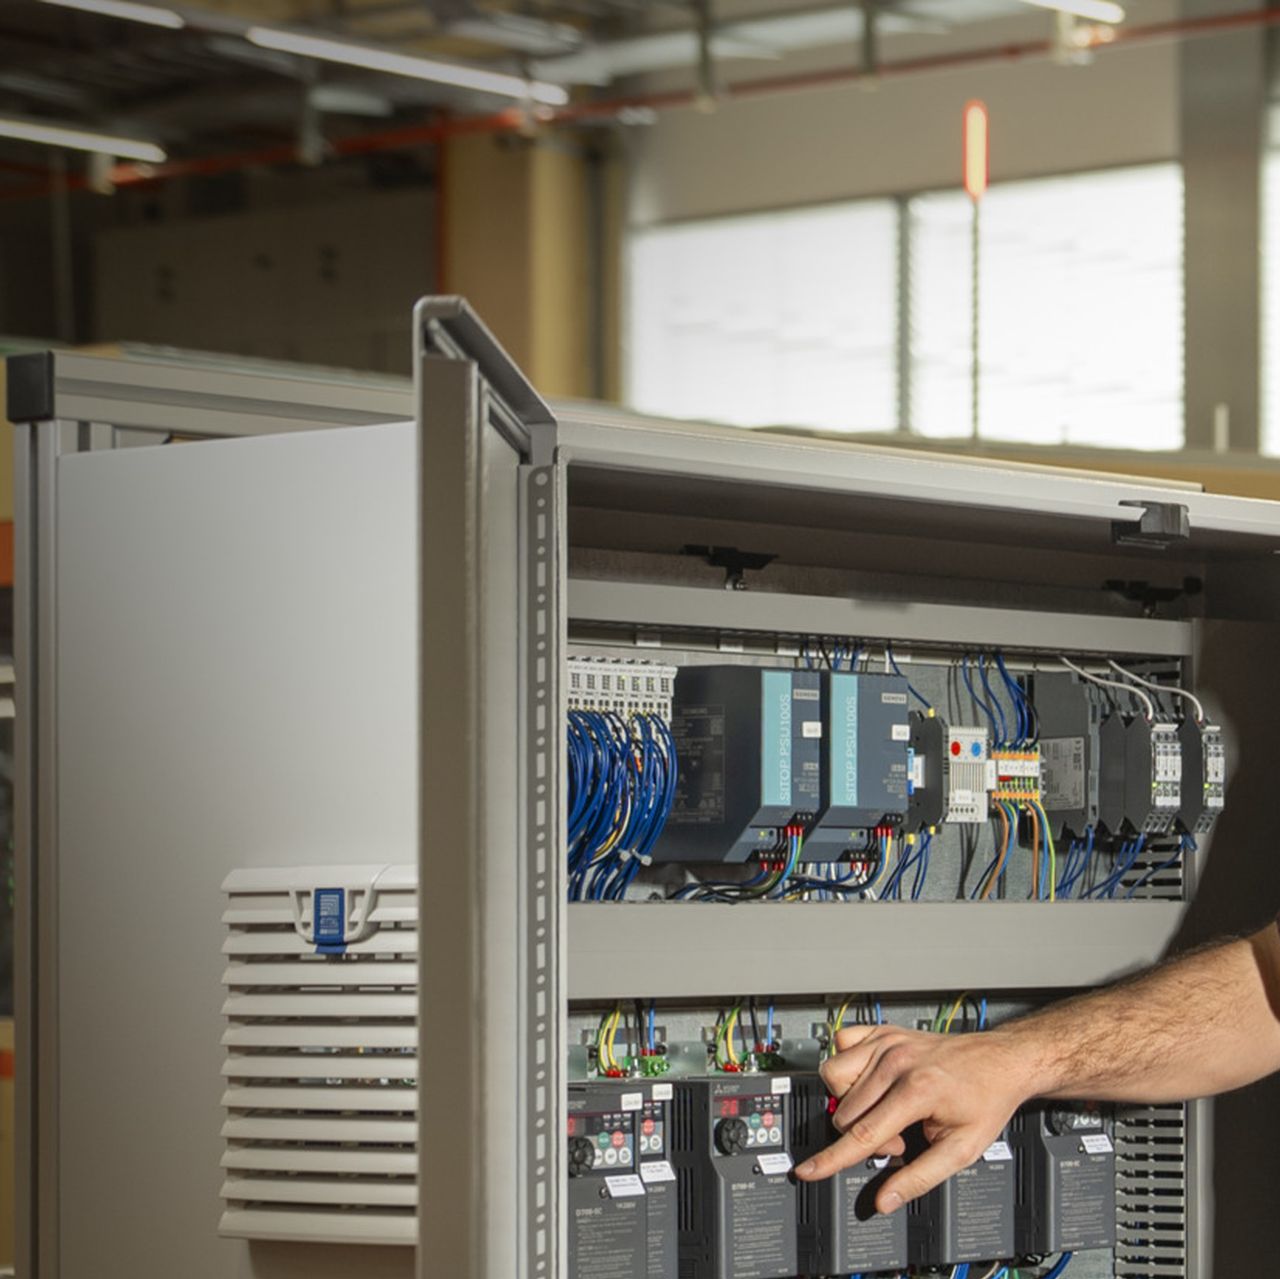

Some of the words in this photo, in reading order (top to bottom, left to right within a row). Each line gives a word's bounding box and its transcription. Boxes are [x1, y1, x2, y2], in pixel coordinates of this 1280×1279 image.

[779, 694, 791, 757] PSU100S
[846, 696, 858, 758] PSU100S
[779, 761, 791, 801] SITOP
[846, 763, 858, 801] SITOP
